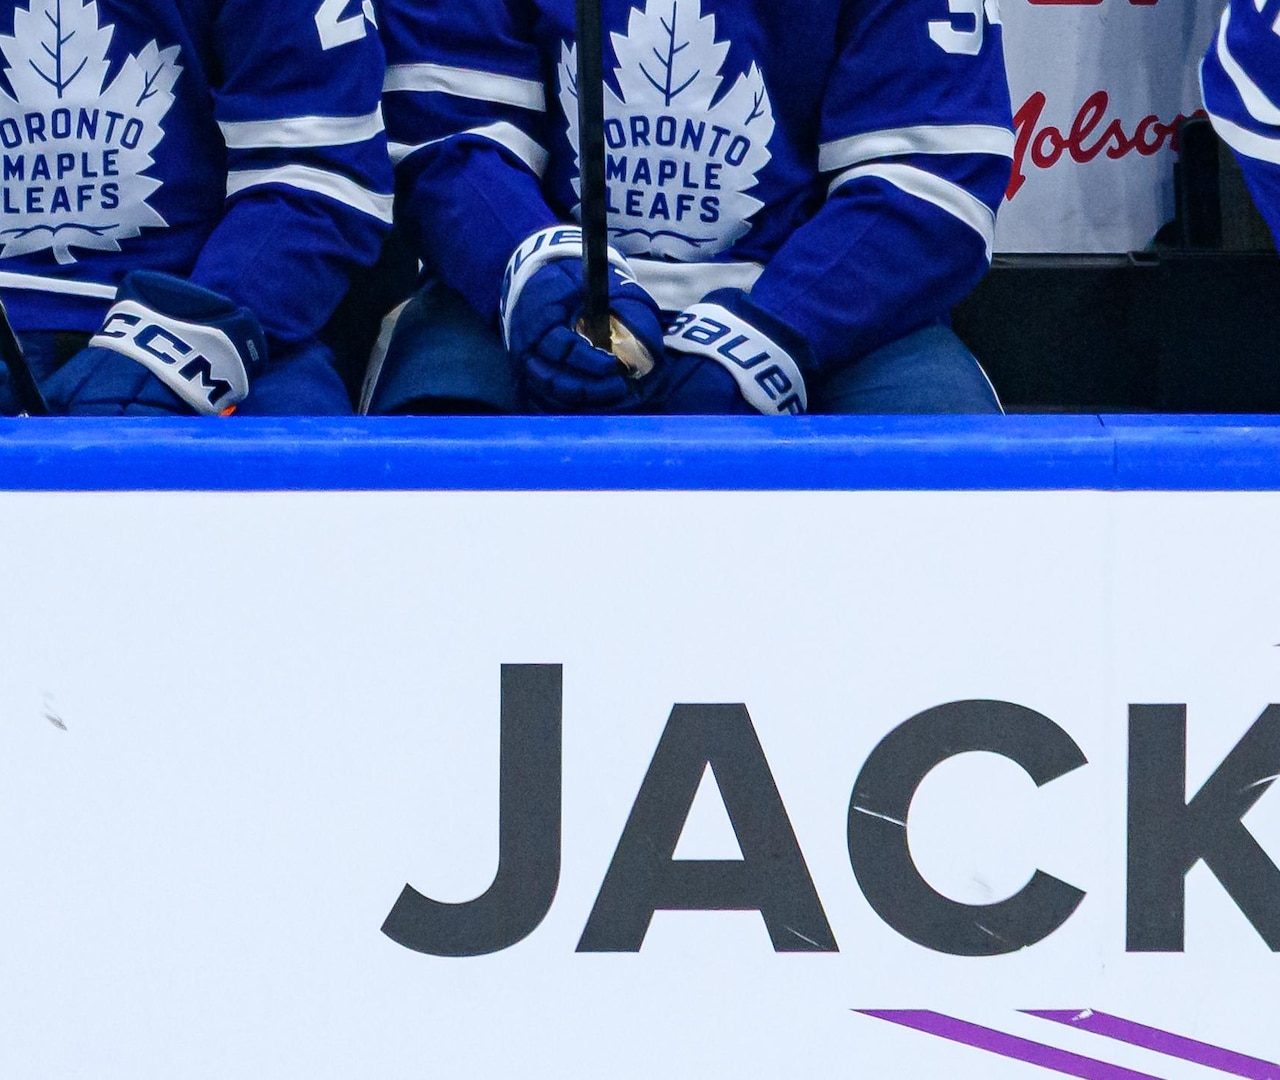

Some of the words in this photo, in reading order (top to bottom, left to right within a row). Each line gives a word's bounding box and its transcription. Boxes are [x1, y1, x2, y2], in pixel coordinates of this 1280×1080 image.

[604, 115, 751, 167] ORONTO
[3, 149, 120, 181] MAPLE
[606, 154, 722, 190] MAPLE
[3, 183, 120, 214] LEAFS
[606, 186, 721, 223] LEAFS
[103, 313, 233, 407] CCM
